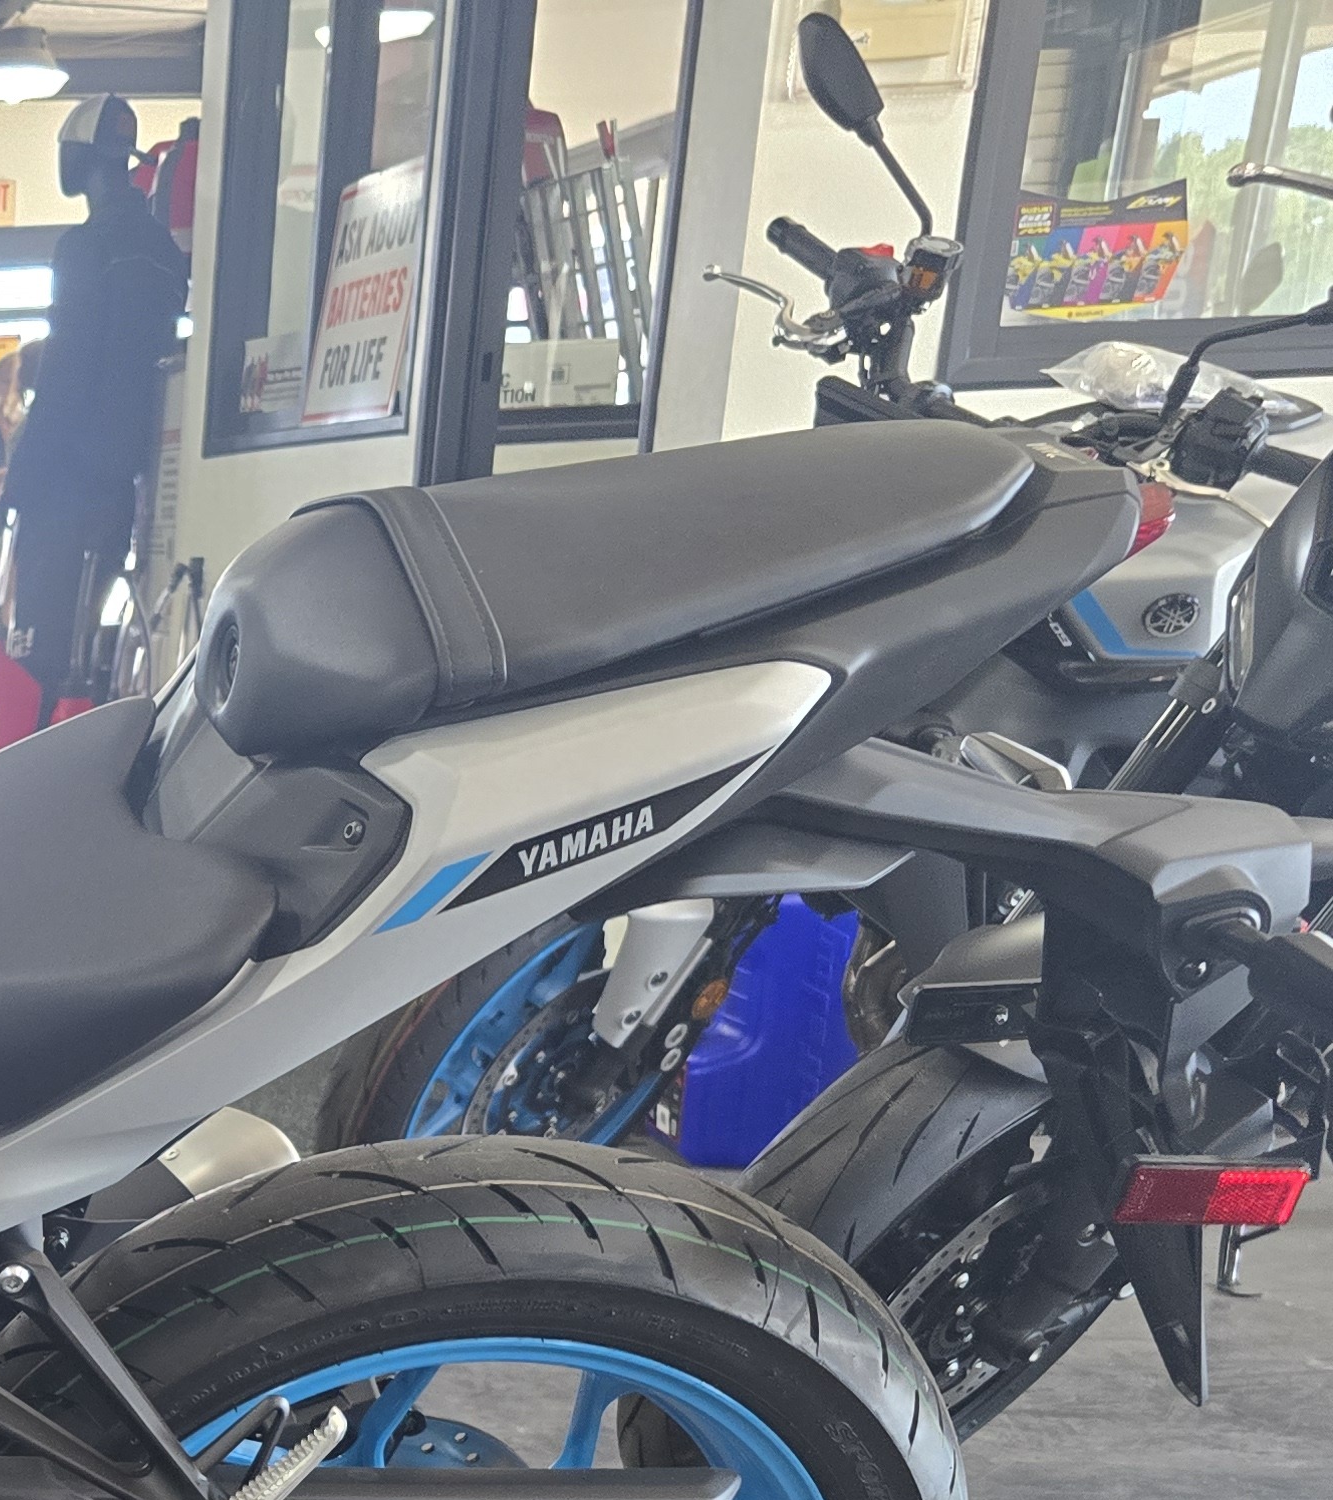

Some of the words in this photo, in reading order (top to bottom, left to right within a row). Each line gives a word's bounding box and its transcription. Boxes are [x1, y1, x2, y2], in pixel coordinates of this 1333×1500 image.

[335, 217, 367, 268] ASK
[326, 266, 407, 329] BATTERIES
[319, 342, 350, 390] FOR
[349, 336, 387, 384] LIFE
[518, 805, 654, 877] YAMAHA
